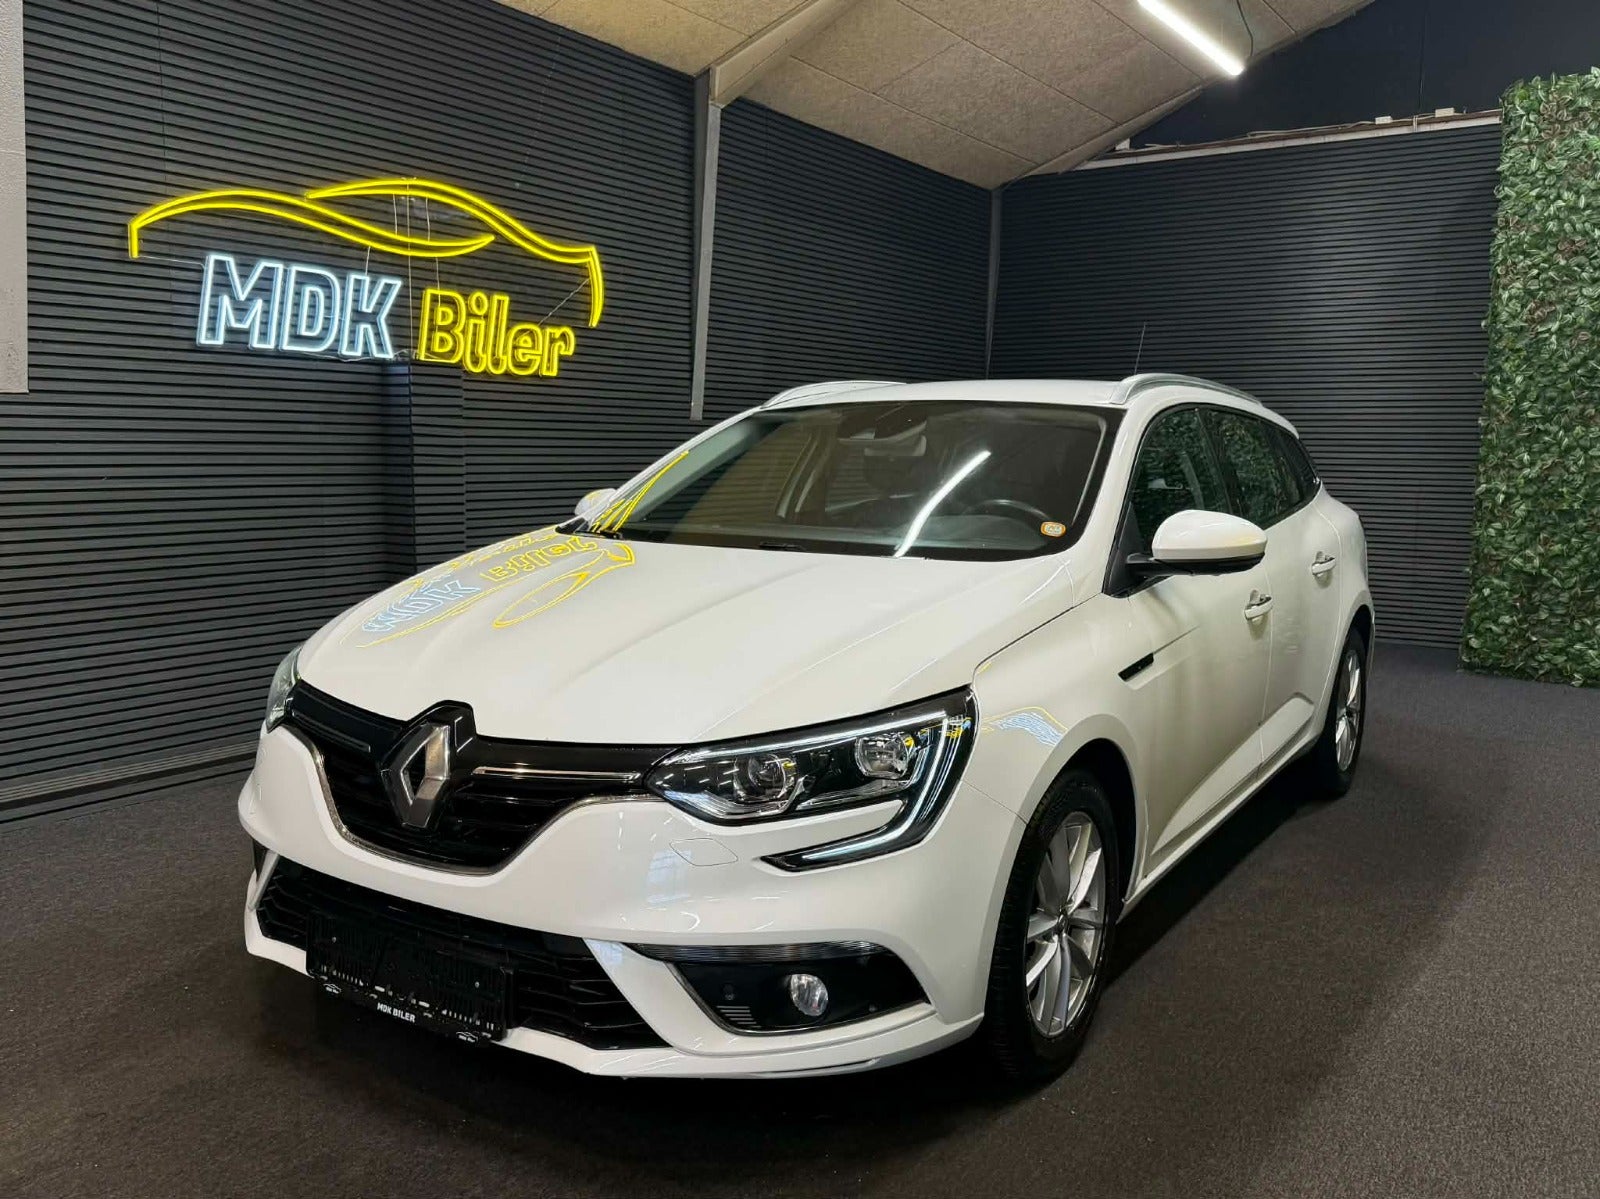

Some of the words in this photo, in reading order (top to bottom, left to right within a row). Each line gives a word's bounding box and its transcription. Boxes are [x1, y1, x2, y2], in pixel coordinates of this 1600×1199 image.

[198, 254, 402, 359] MDK
[418, 288, 575, 377] Biler
[376, 1002, 392, 1015] MDK
[392, 1007, 416, 1023] BILER
